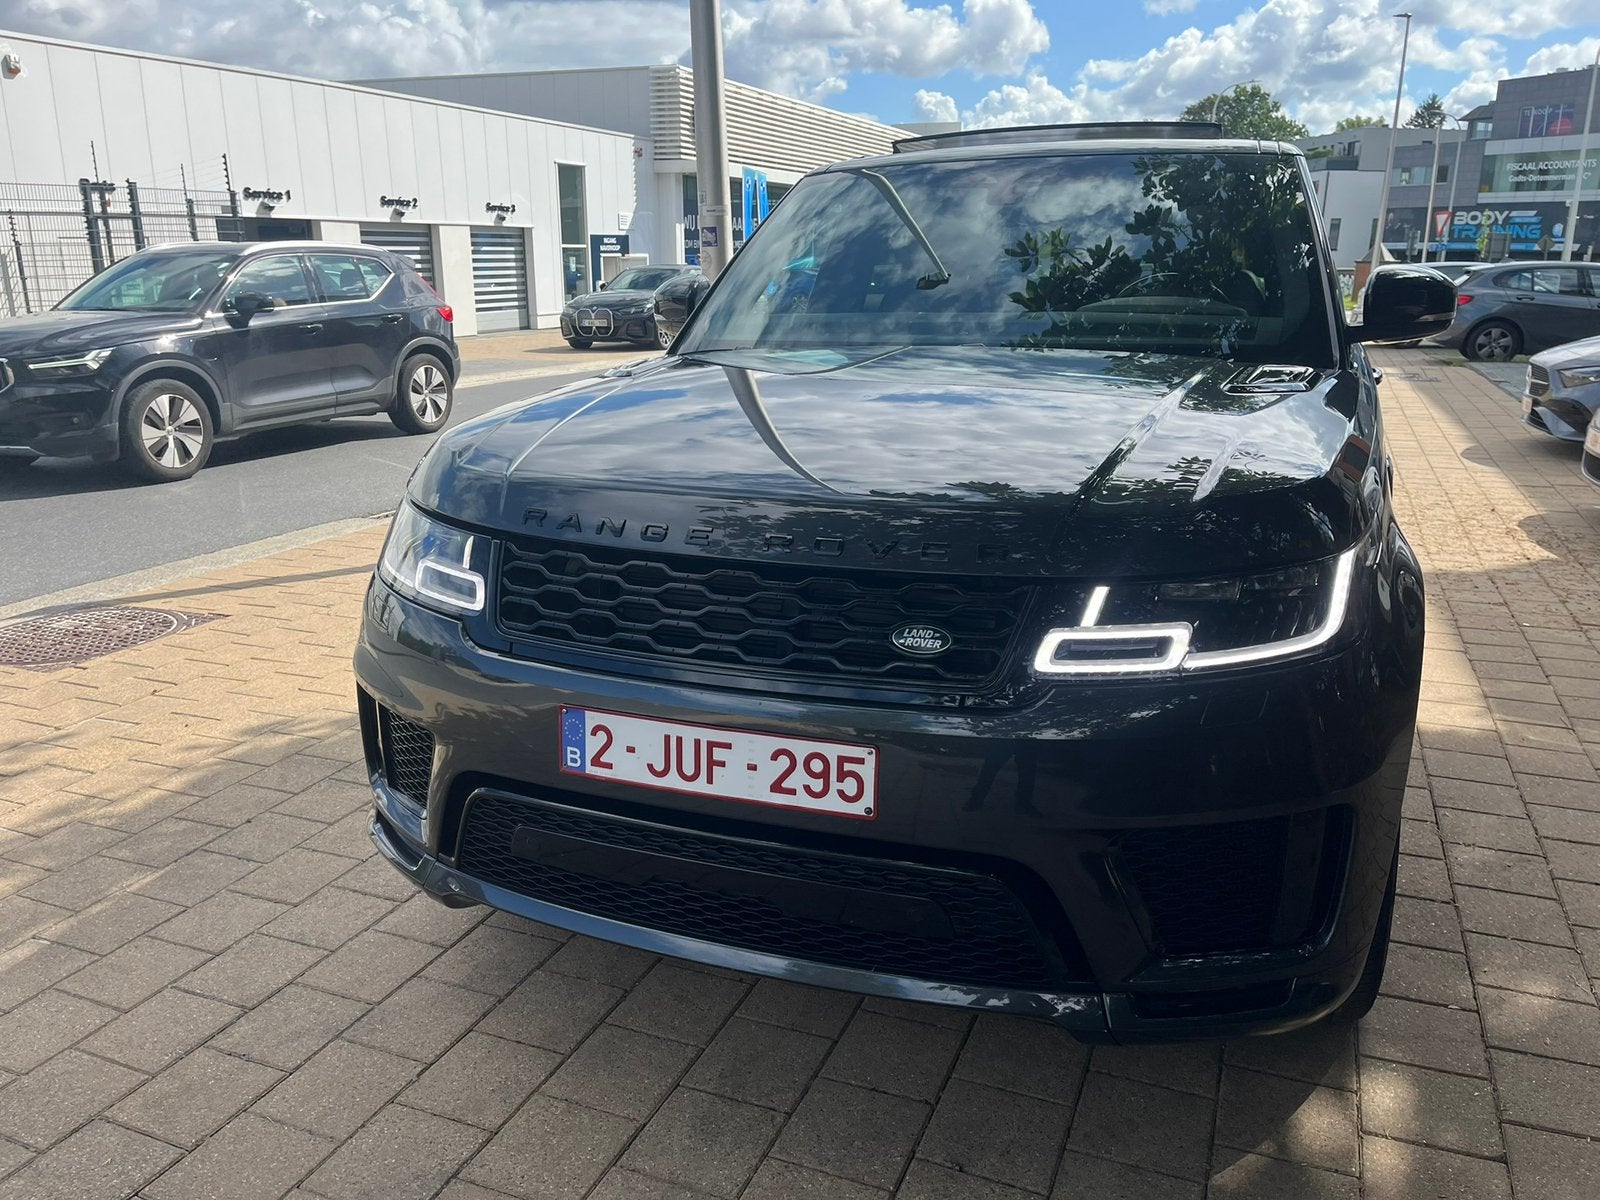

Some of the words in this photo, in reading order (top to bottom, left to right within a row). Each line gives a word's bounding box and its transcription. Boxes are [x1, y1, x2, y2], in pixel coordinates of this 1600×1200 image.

[1506, 162, 1537, 172] FISCAAL
[1537, 159, 1597, 170] ACCOUNTANTS
[242, 187, 283, 201] Service
[284, 189, 291, 202] 1
[380, 195, 411, 207] Service
[411, 197, 418, 208] 2
[485, 202, 510, 213] Service
[510, 204, 516, 213] 3
[1454, 210, 1509, 225] BODY
[521, 506, 714, 547] RANGE
[762, 531, 1010, 565] ROVER
[903, 628, 934, 639] LAND
[904, 637, 942, 649] ROVER
[566, 746, 581, 768] B
